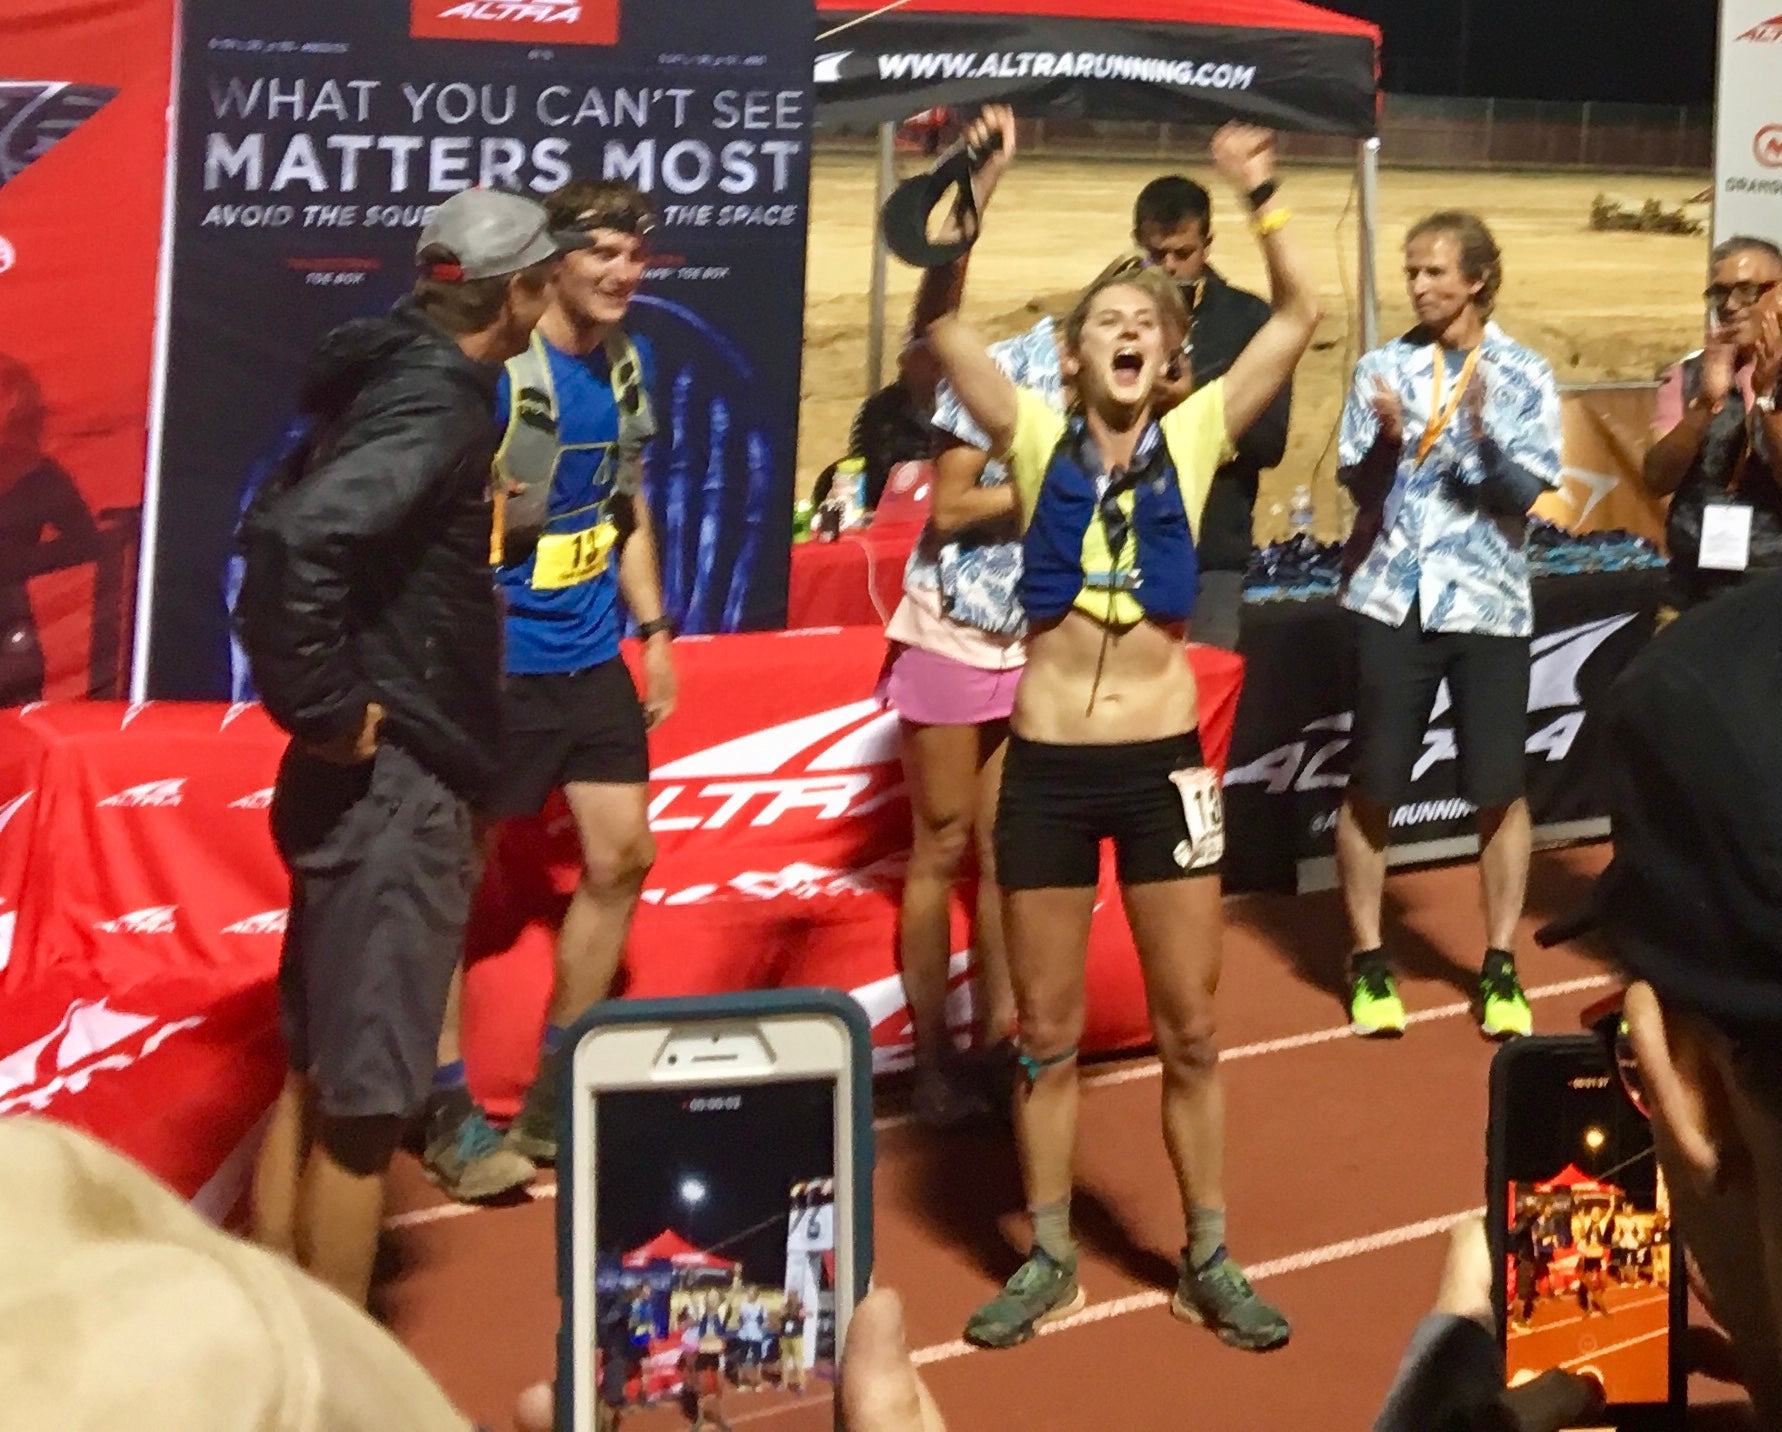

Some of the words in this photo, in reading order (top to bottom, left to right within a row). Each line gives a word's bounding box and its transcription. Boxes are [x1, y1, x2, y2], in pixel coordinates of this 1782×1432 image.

[436, 1, 583, 25] ALTRA
[878, 51, 1257, 90] WWW.ALTRARUNNING.COM
[206, 76, 382, 121] WHAT
[401, 81, 519, 124] YOU
[536, 84, 696, 128] CAN'T
[712, 89, 804, 130] SEE
[203, 131, 573, 195] MATTERS
[602, 137, 803, 195] MOST
[201, 203, 295, 228] AVOID
[302, 204, 361, 228] THE
[663, 204, 714, 227] THE
[716, 204, 799, 228] SPACE
